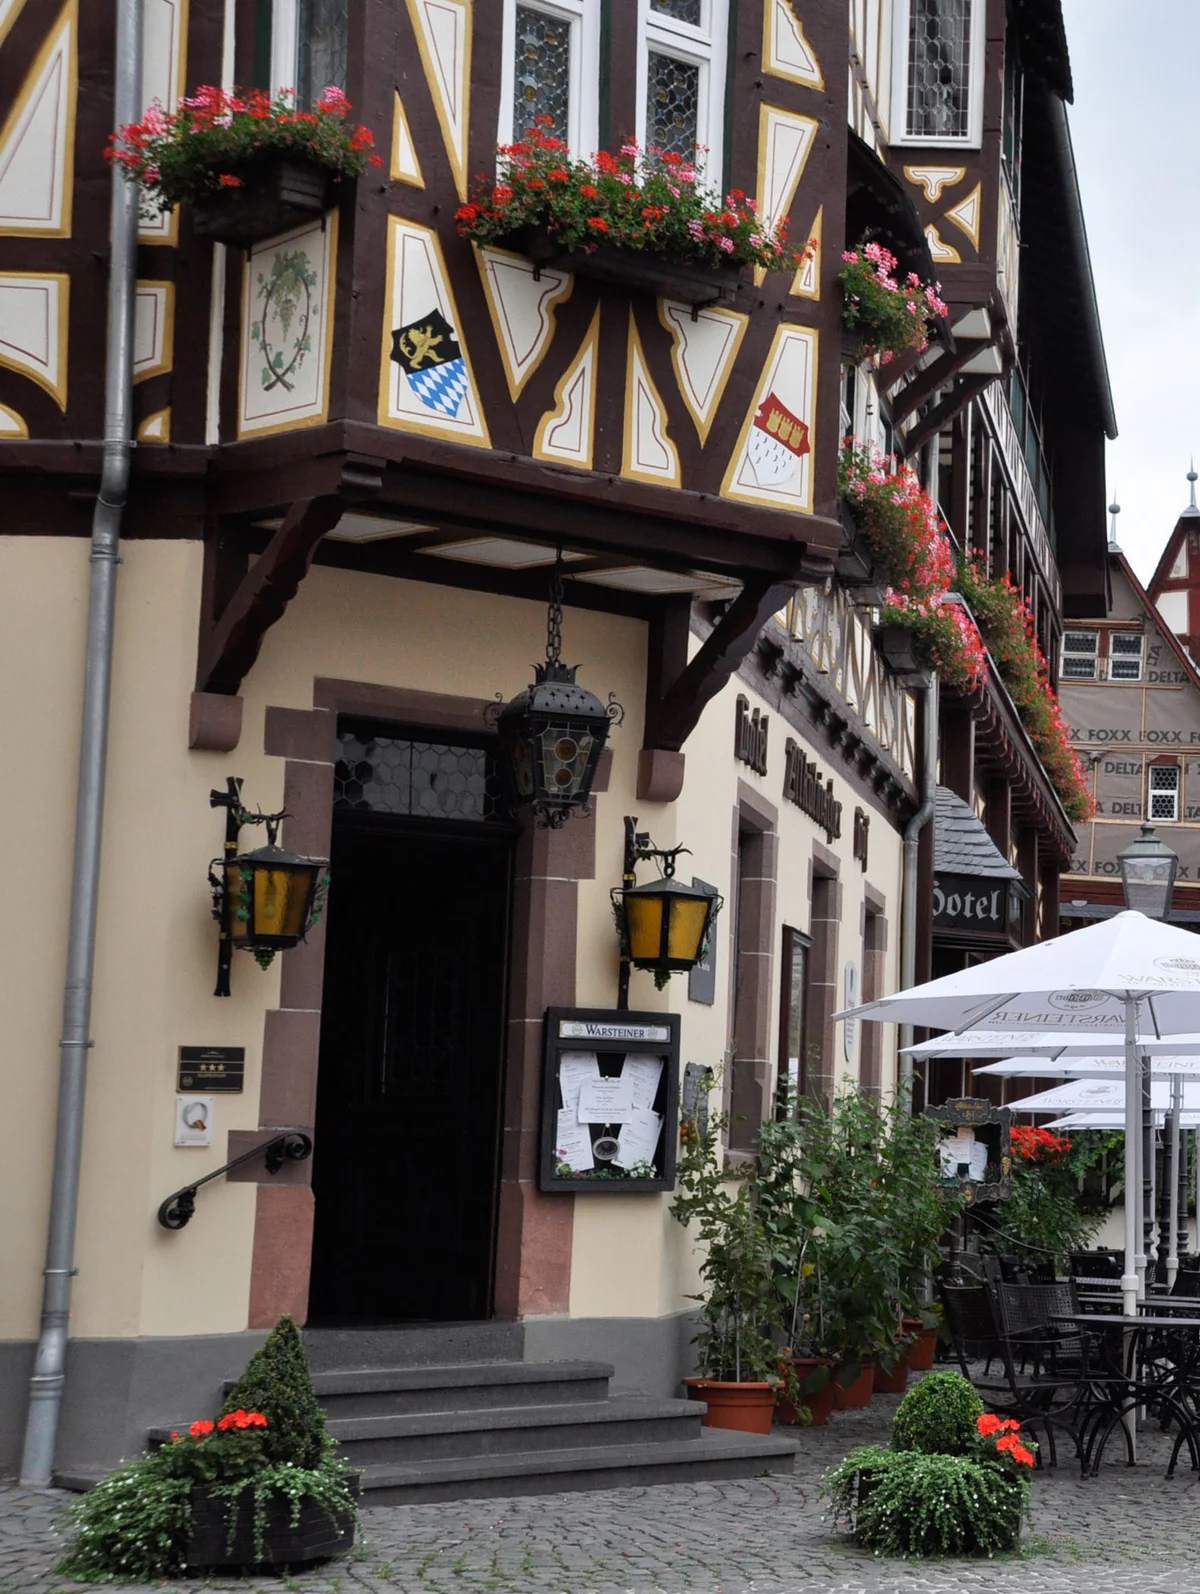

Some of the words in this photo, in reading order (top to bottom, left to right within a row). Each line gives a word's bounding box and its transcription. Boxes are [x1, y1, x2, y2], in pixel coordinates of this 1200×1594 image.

[1149, 671, 1191, 683] DELTA
[1088, 729, 1132, 742] FOXX
[585, 1024, 645, 1038] WARSTEINER
